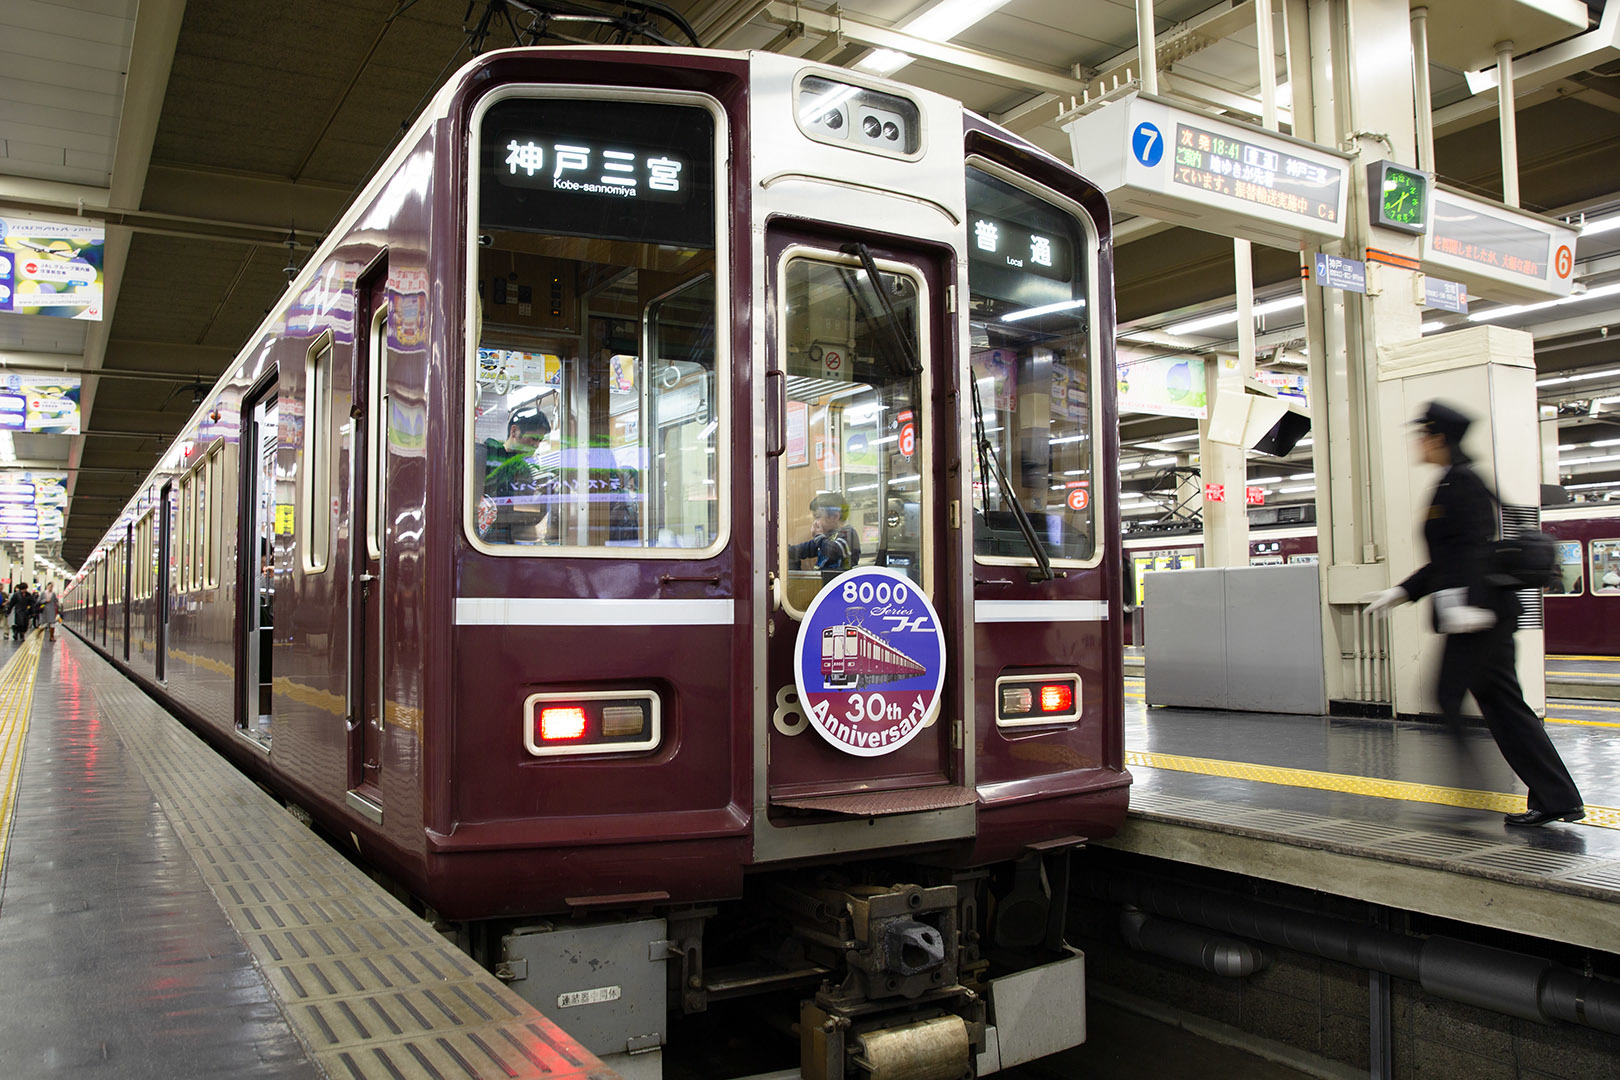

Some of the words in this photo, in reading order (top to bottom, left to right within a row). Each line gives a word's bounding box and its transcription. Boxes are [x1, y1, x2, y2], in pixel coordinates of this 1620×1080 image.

[1140, 127, 1158, 161] 7
[1175, 147, 1202, 168] ご案内
[505, 139, 682, 192] 神戸三宮
[1212, 137, 1240, 160] 18:41
[1286, 158, 1329, 185] 神戸三宮
[553, 178, 637, 197] Kobe-sannomiya
[974, 219, 1053, 267] 普通
[1006, 256, 1023, 268] Local
[1318, 264, 1325, 276] 7
[1558, 249, 1569, 276] 6
[842, 581, 908, 605] 8000
[869, 603, 914, 618] Series
[812, 693, 927, 749] Anniversary
[845, 692, 902, 723] 30th
